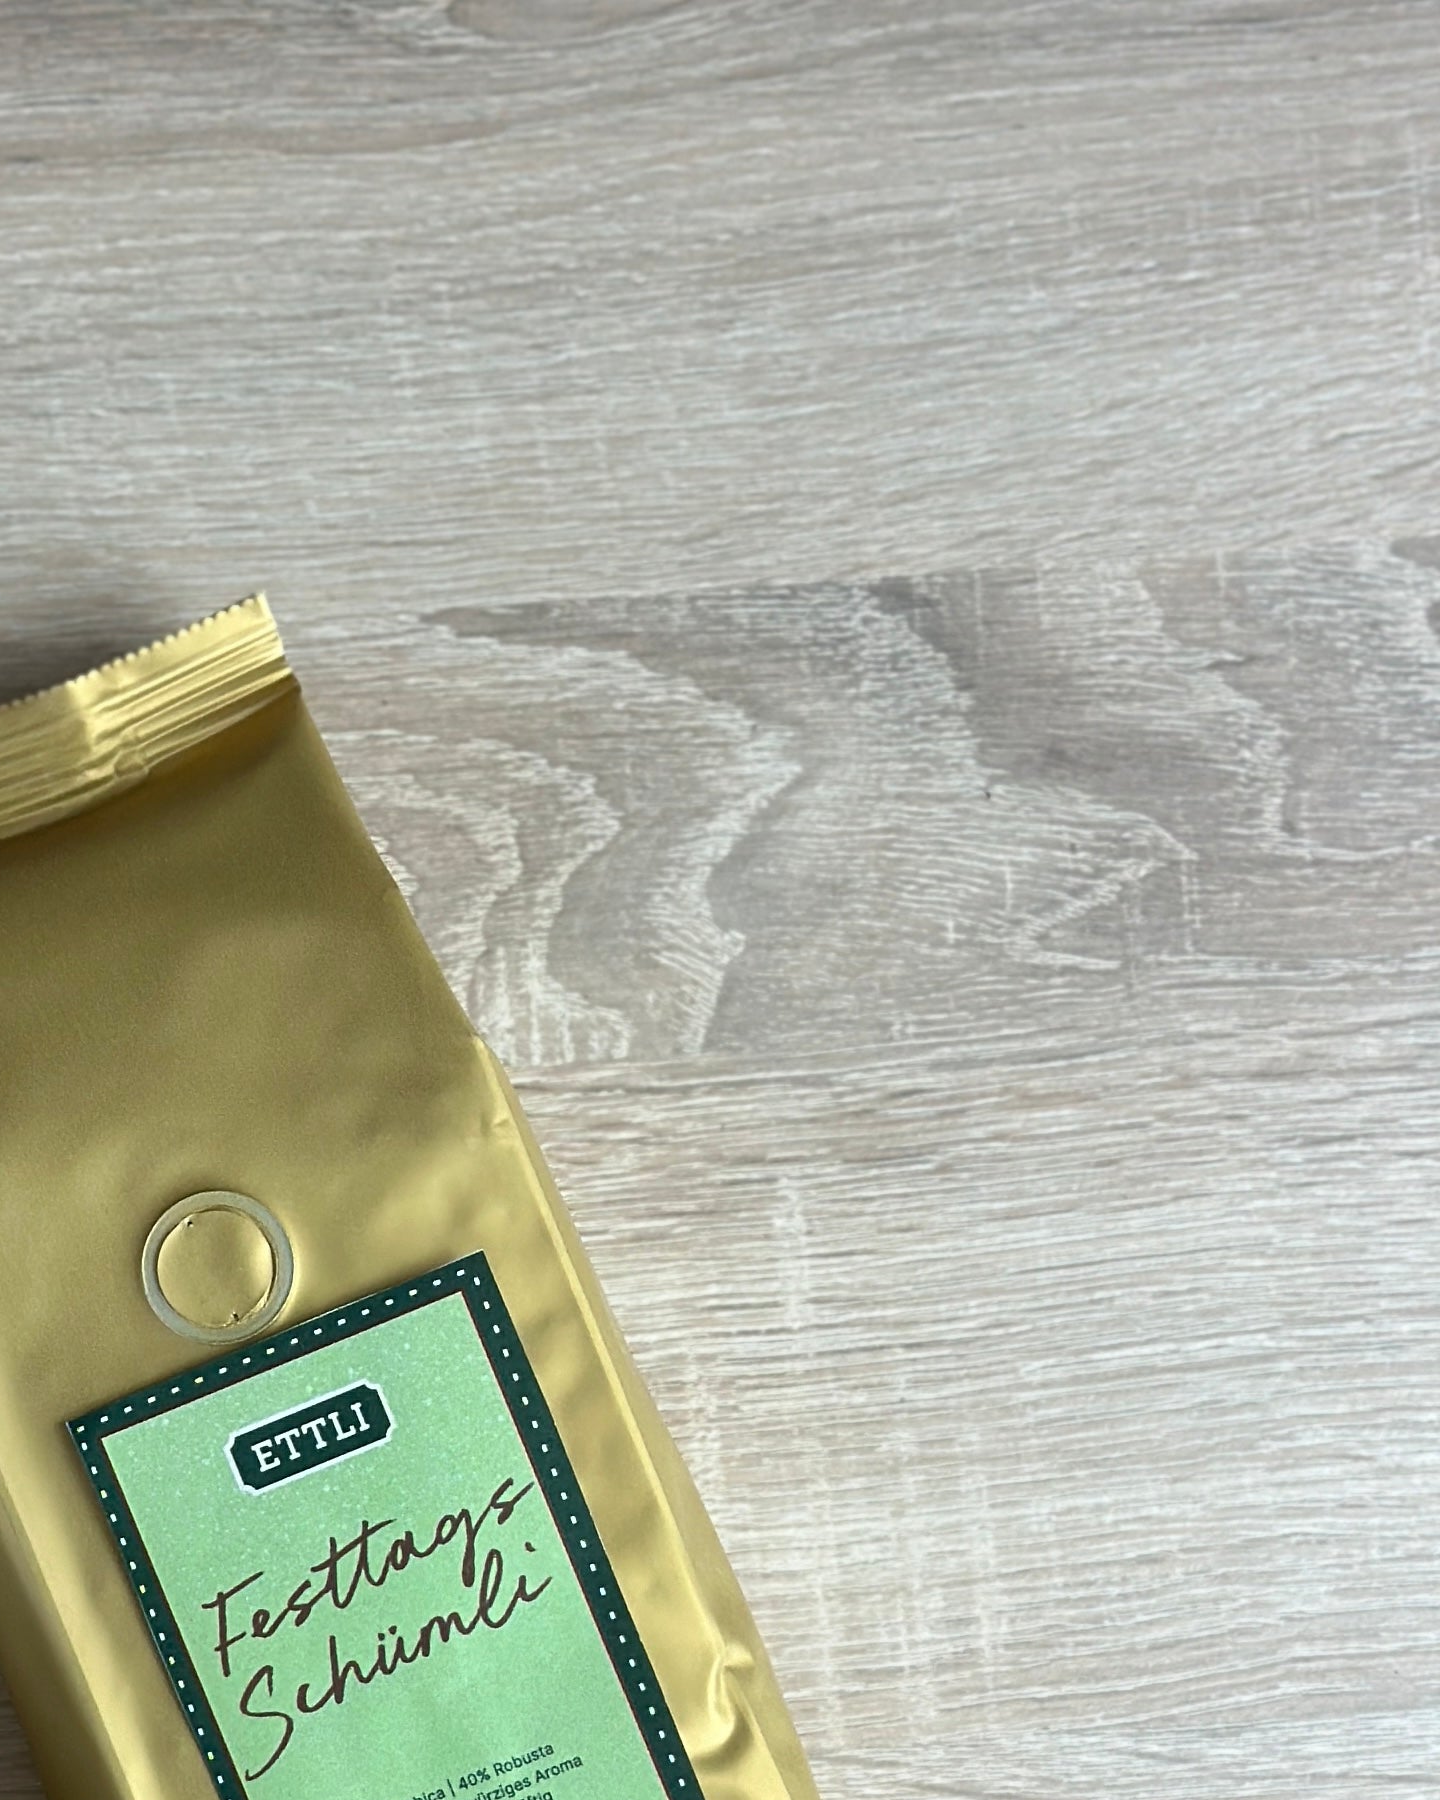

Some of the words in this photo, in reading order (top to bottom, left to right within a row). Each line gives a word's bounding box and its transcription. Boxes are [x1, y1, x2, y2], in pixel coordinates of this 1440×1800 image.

[251, 1401, 373, 1474] ETTLI
[202, 1477, 535, 1678] Festtags
[239, 1541, 552, 1781] Schümli
[459, 1768, 491, 1791] 40%
[493, 1743, 555, 1777] Robusta
[535, 1754, 584, 1784] Aroma
